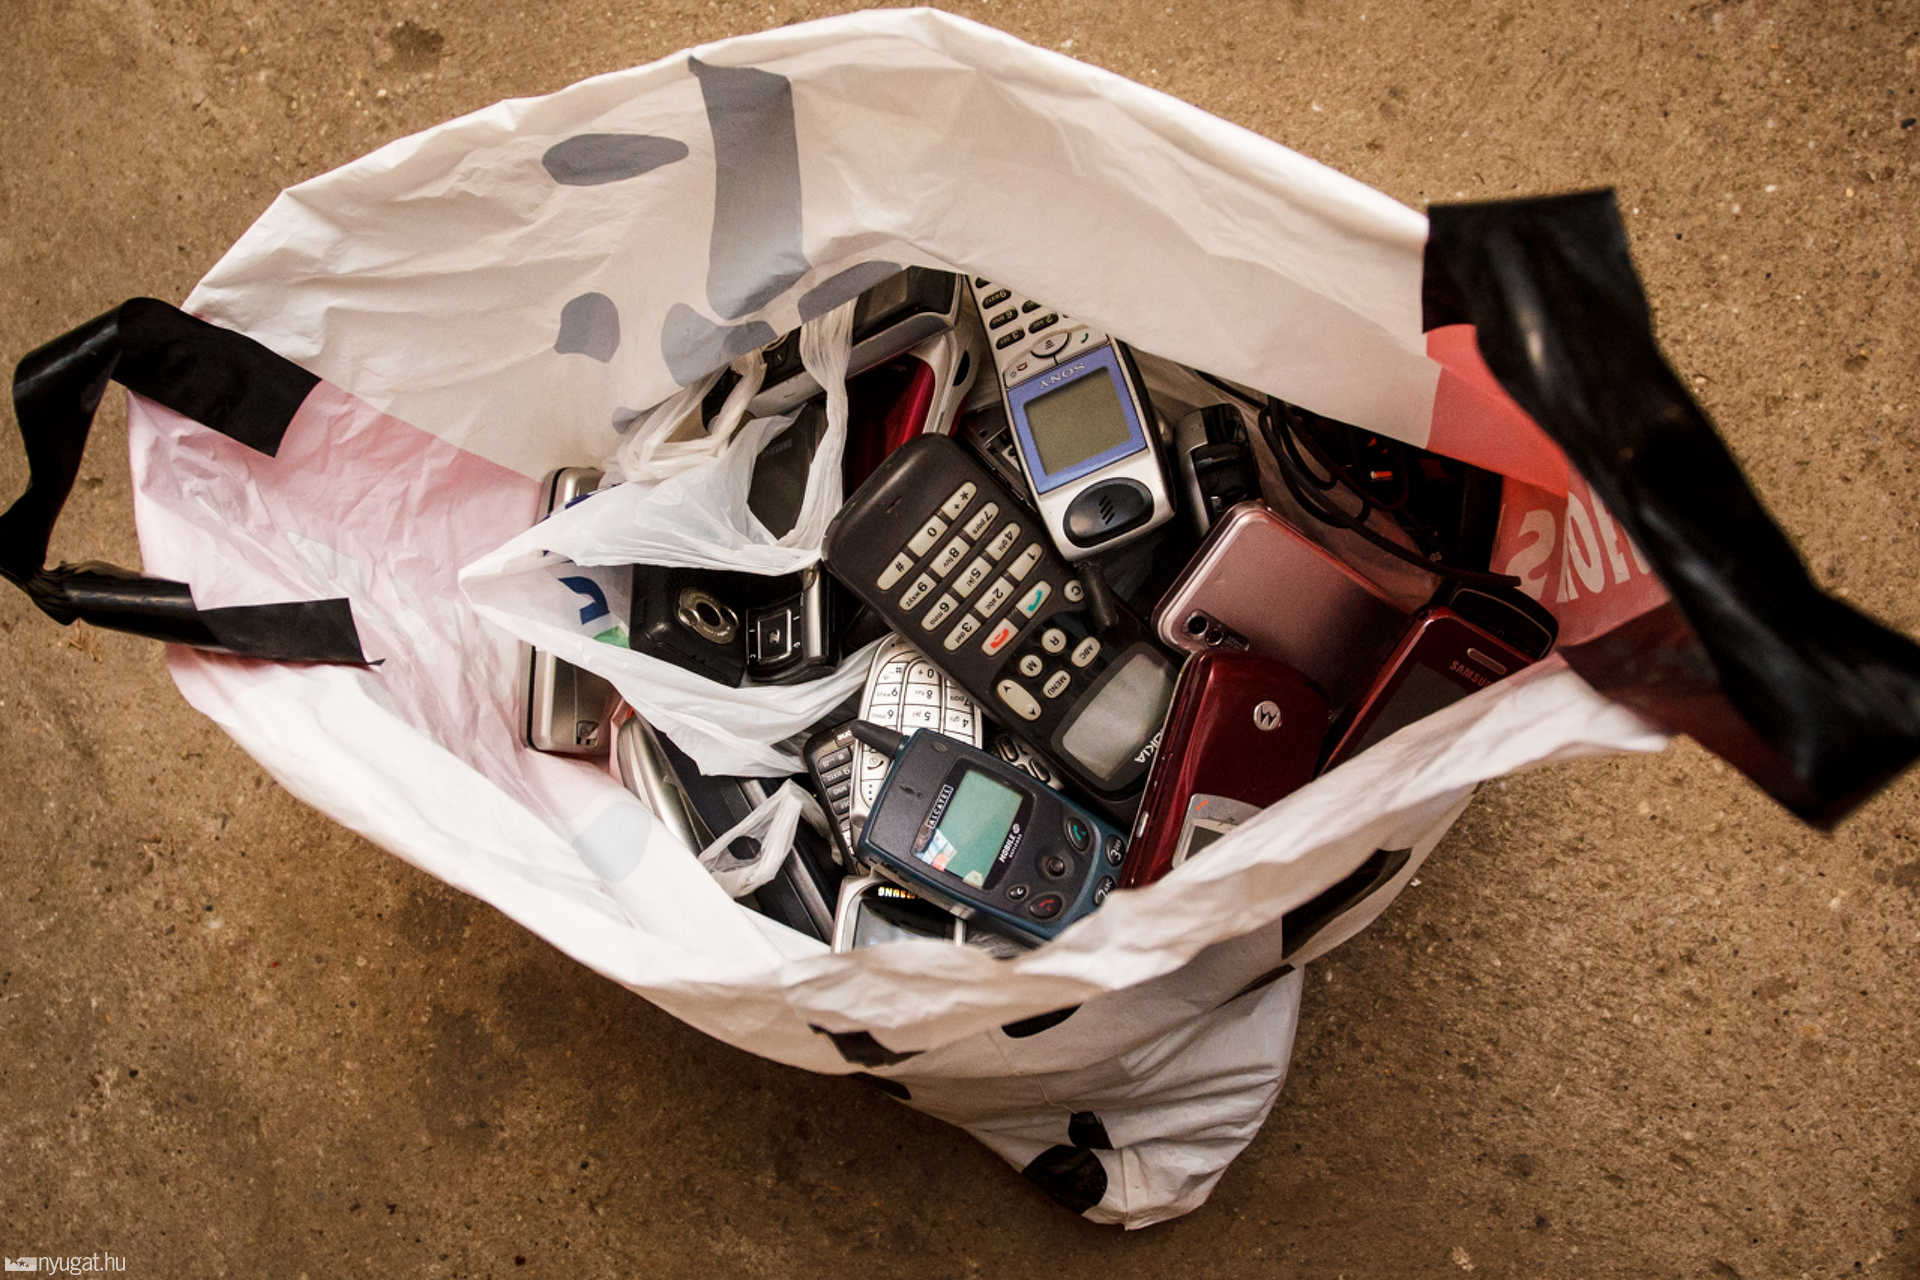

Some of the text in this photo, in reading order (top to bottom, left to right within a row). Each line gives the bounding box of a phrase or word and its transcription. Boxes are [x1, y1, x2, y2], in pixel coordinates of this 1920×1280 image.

[1040, 362, 1085, 389] SONY
[927, 527, 937, 538] 0
[1071, 585, 1083, 596] C
[1050, 636, 1060, 646] R
[1079, 644, 1093, 660] ABC
[1449, 660, 1491, 686] SAMSU
[1047, 675, 1067, 696] MENU
[1134, 732, 1164, 763] OKIA
